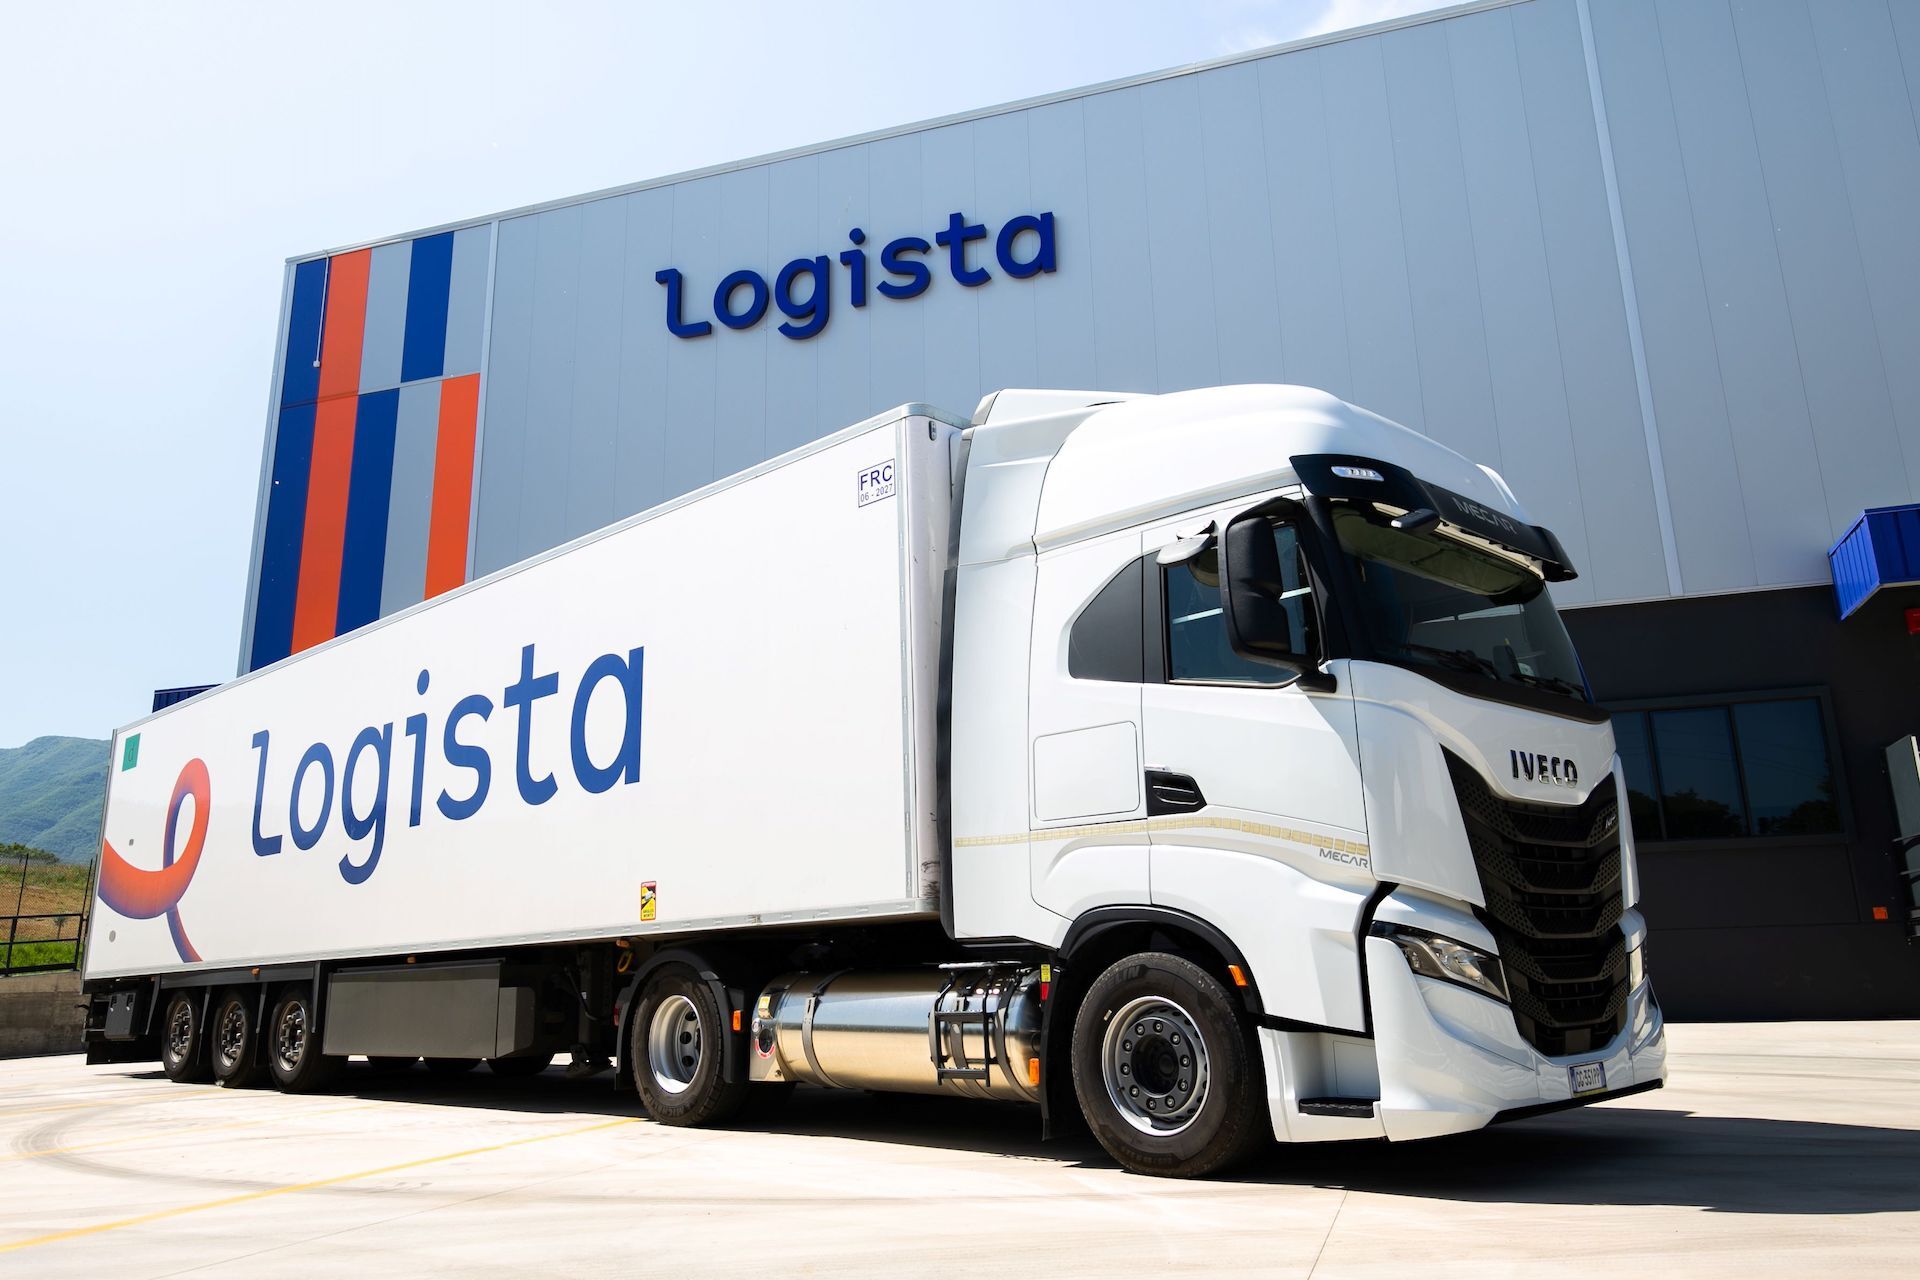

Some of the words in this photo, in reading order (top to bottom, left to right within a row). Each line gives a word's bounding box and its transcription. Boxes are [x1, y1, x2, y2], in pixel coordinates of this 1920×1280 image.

[655, 211, 1057, 340] logista
[860, 465, 893, 491] FRC
[1451, 497, 1518, 535] MECAR
[252, 643, 644, 884] logista
[1509, 749, 1579, 788] IVECO
[1319, 847, 1369, 869] MECAR
